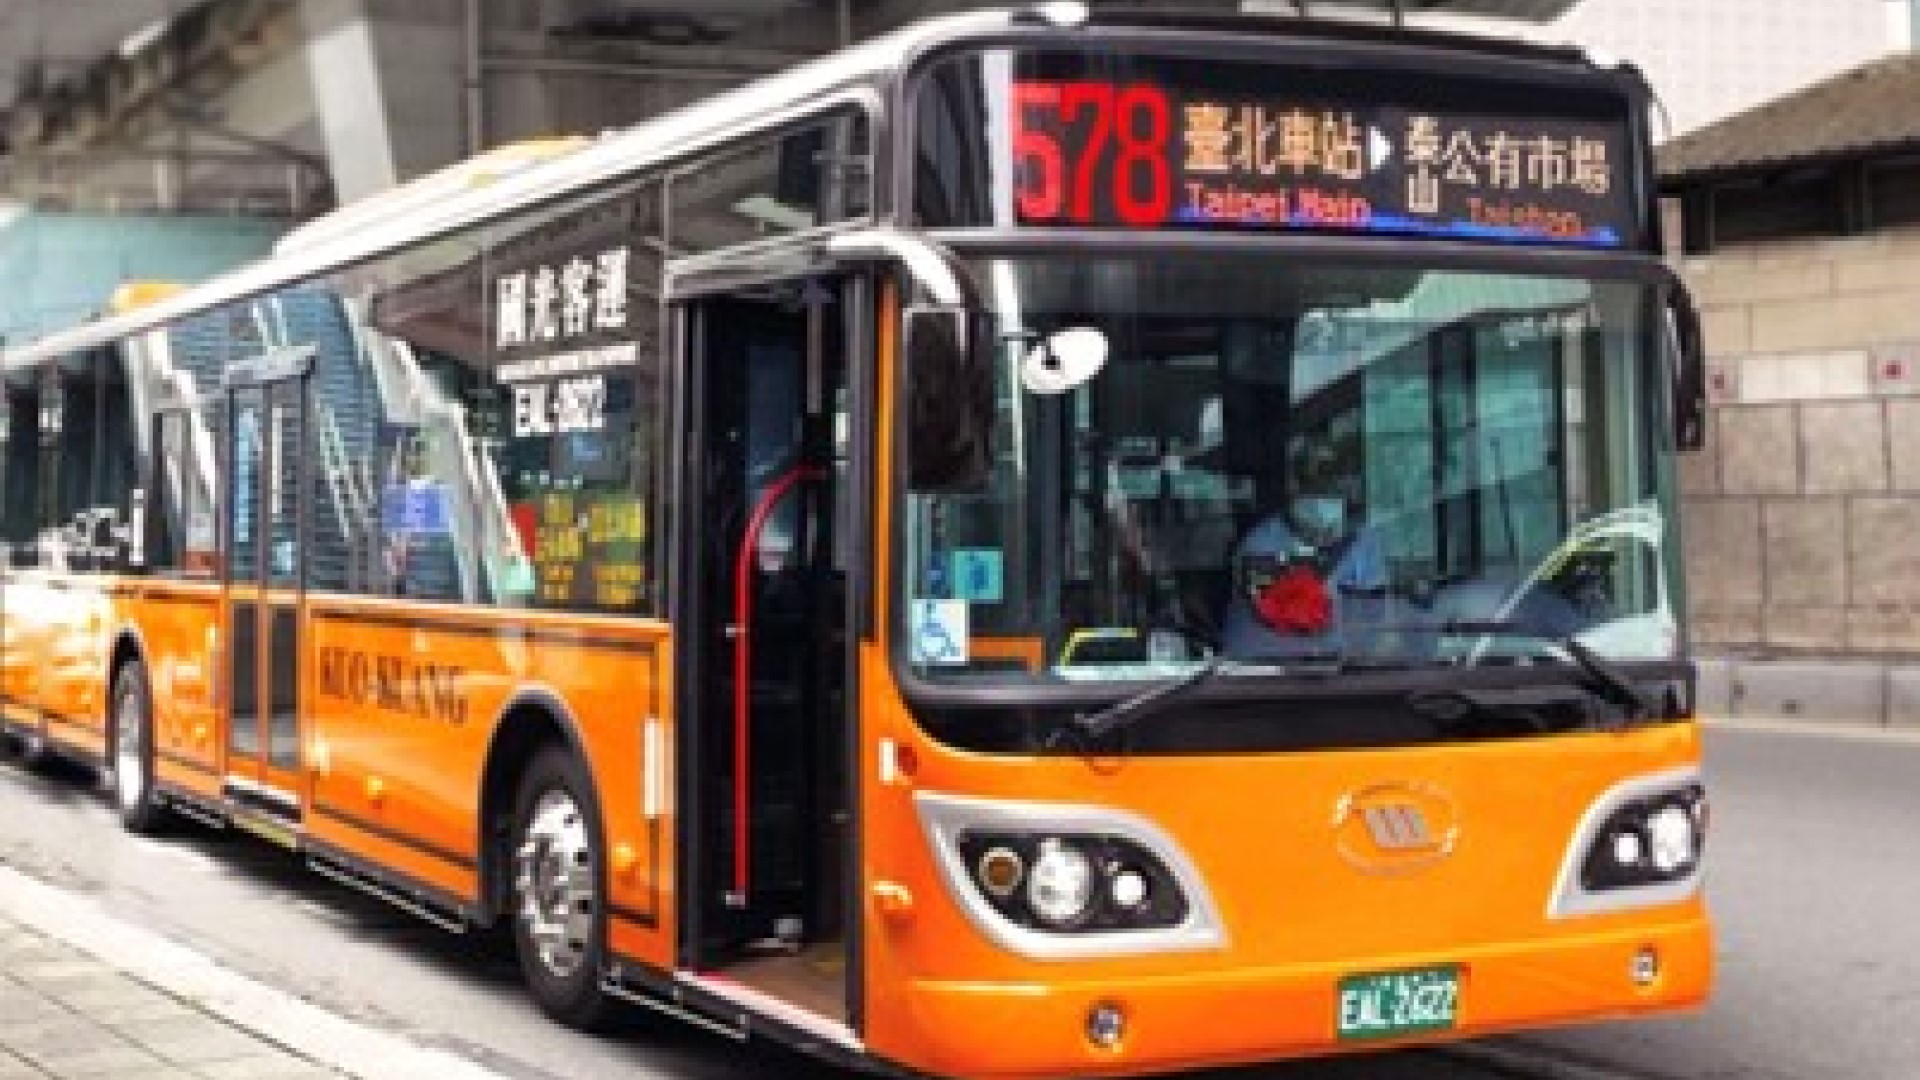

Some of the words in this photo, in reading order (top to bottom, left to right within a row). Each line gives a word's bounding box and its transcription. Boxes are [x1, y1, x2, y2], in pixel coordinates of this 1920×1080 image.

[1012, 80, 1171, 227] 578
[1183, 101, 1363, 180] 臺北車站
[1184, 182, 1291, 223] Taipei
[1298, 186, 1371, 224] Main
